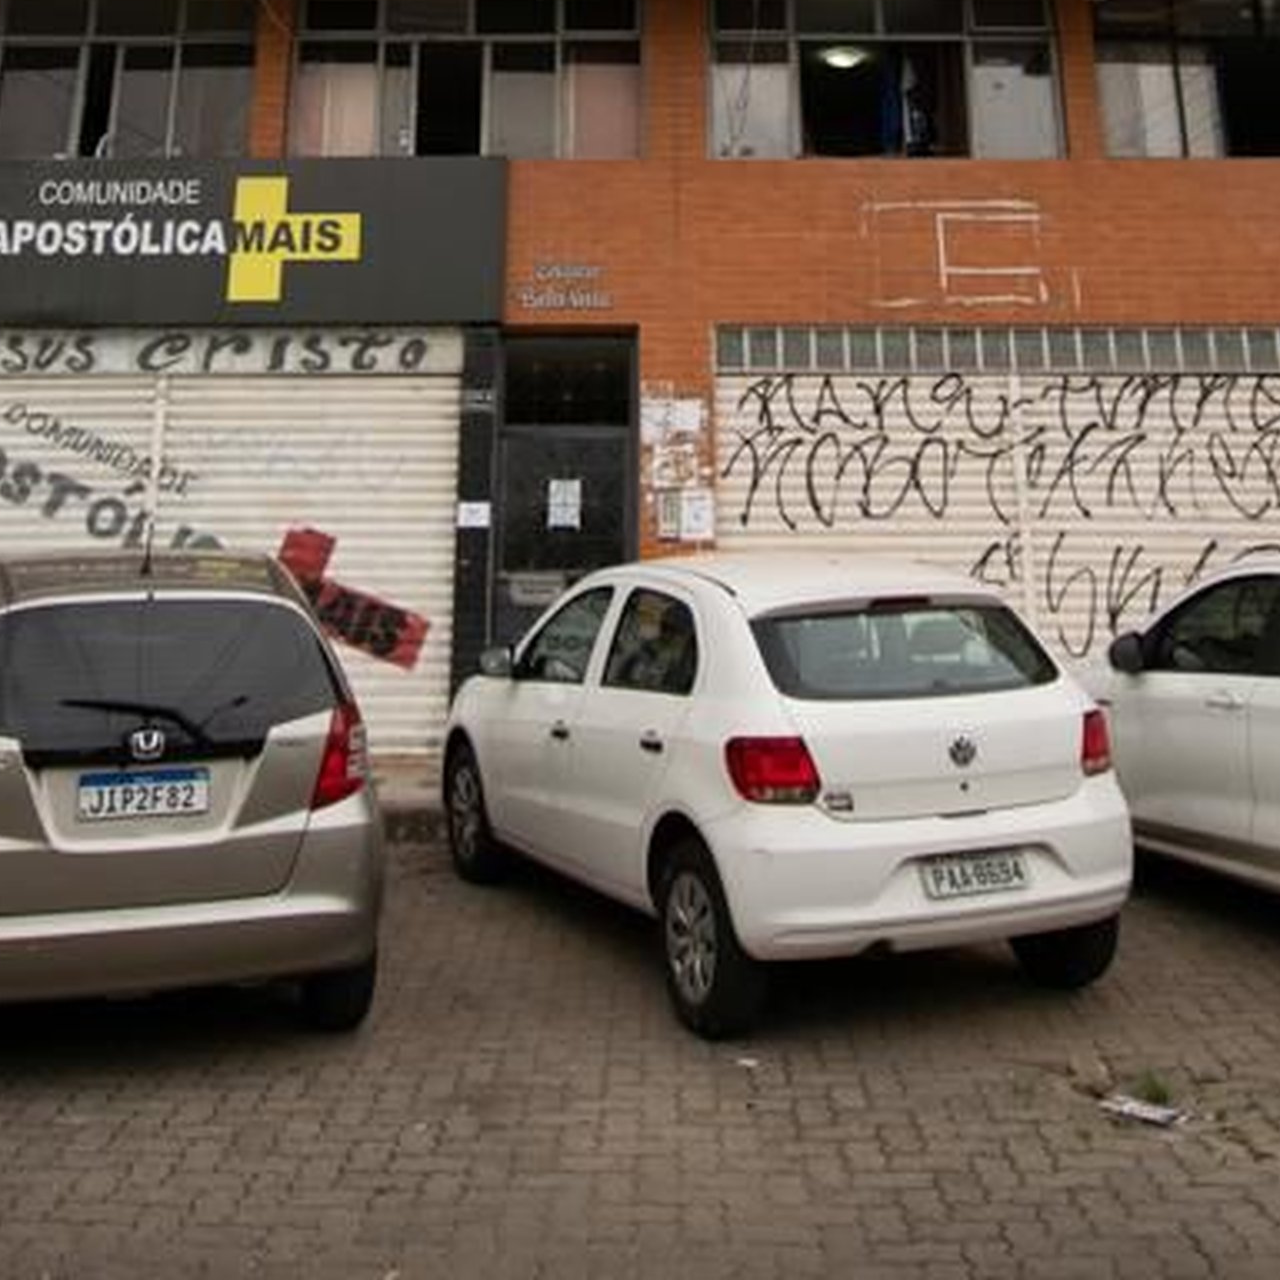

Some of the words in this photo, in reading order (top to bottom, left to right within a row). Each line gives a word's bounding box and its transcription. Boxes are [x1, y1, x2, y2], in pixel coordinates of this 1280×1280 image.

[38, 179, 202, 206] COMUNIDADE
[229, 220, 344, 255] MAIS
[89, 784, 195, 814] JIP2F82
